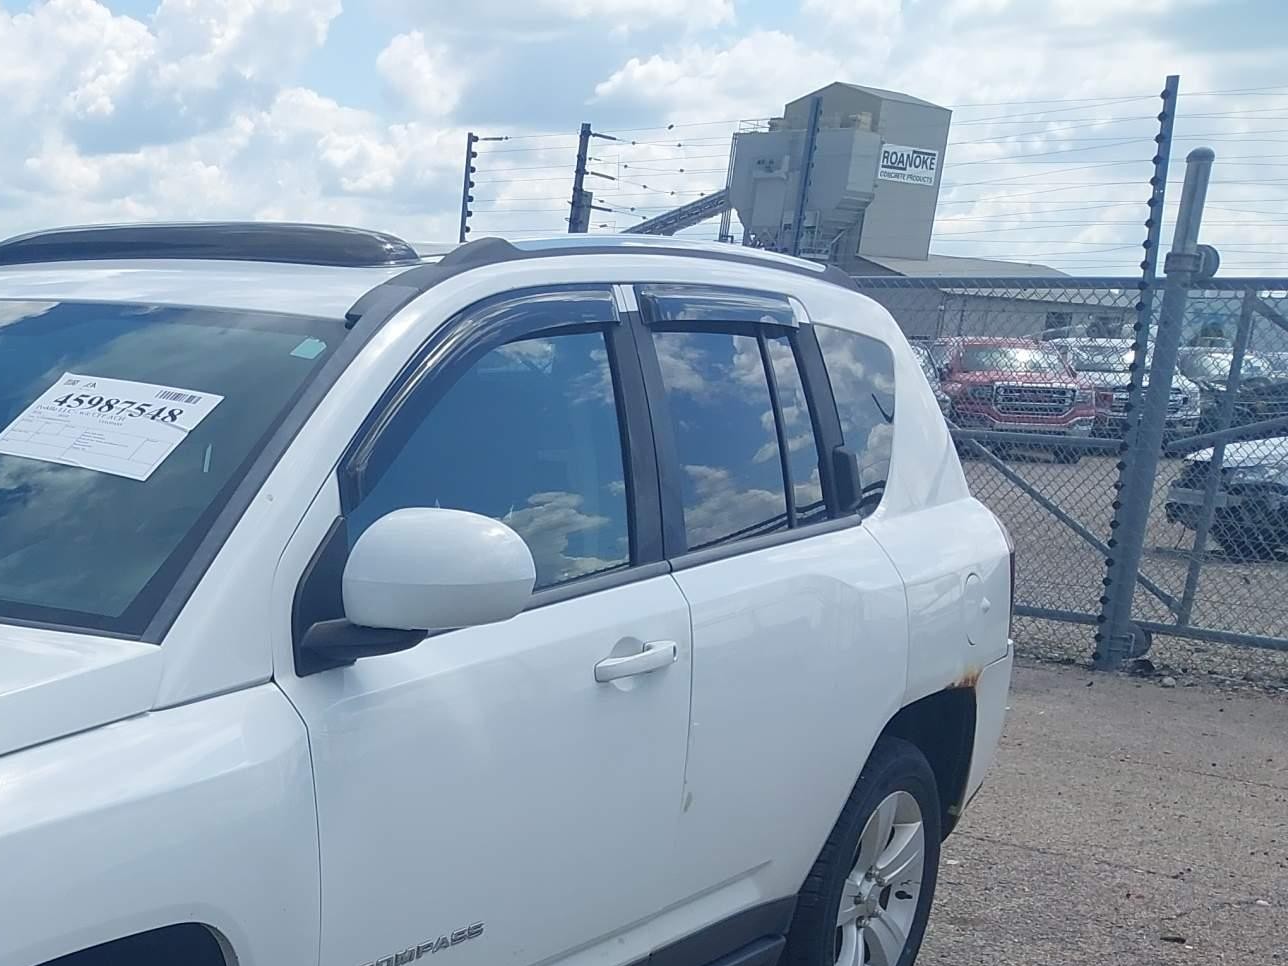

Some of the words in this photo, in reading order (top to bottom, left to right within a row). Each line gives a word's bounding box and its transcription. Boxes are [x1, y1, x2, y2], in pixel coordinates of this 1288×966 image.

[882, 151, 936, 170] ROANOKE
[880, 171, 906, 180] CONCRETE
[907, 174, 933, 183] PRODUCTS
[53, 393, 184, 423] 45987548
